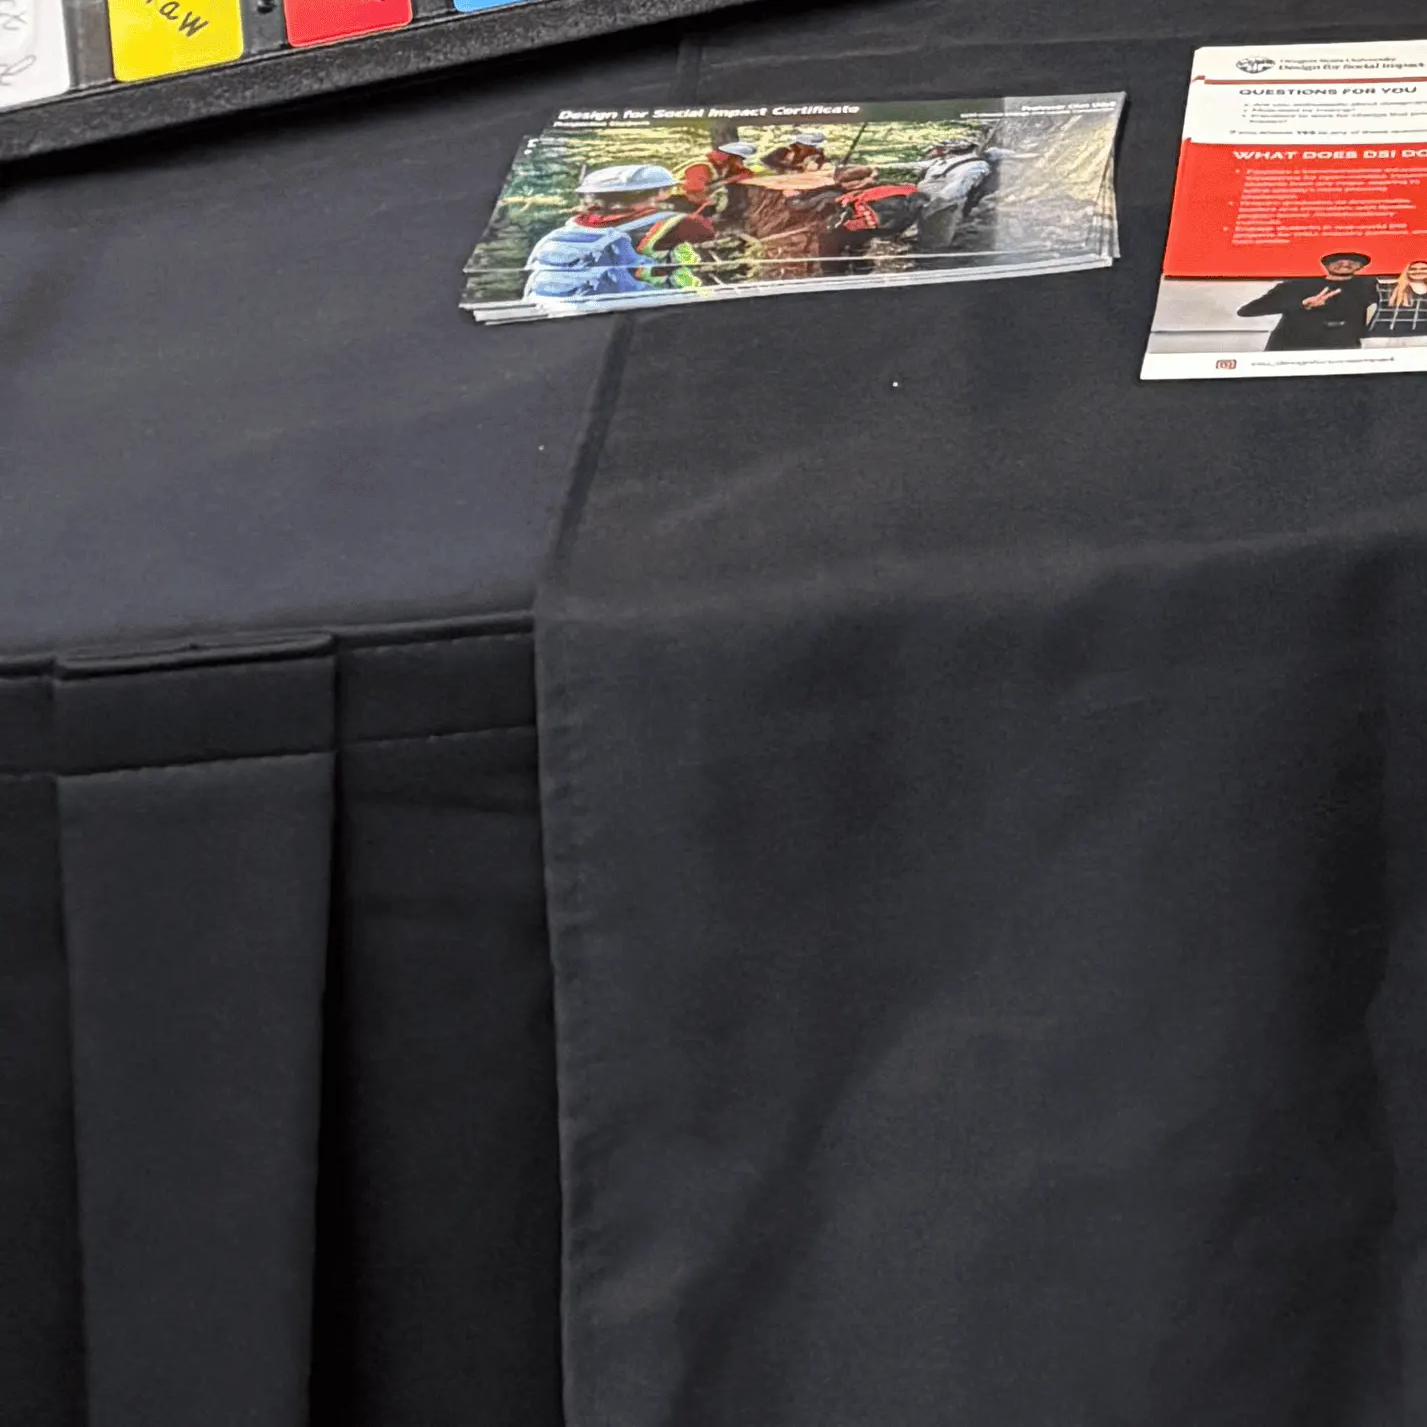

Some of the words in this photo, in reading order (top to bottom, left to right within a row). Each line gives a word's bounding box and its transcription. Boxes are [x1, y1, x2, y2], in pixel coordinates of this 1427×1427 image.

[1239, 88, 1338, 96] QUESTIONS
[1342, 87, 1376, 95] FOR
[1381, 86, 1417, 94] YOU
[558, 109, 618, 121] Design
[623, 109, 649, 119] for
[653, 108, 704, 118] Social
[708, 107, 767, 119] Impact
[772, 105, 860, 116] Certificate
[1232, 151, 1298, 160] WHAT
[1302, 150, 1358, 159] DOES
[1363, 150, 1396, 159] DSI
